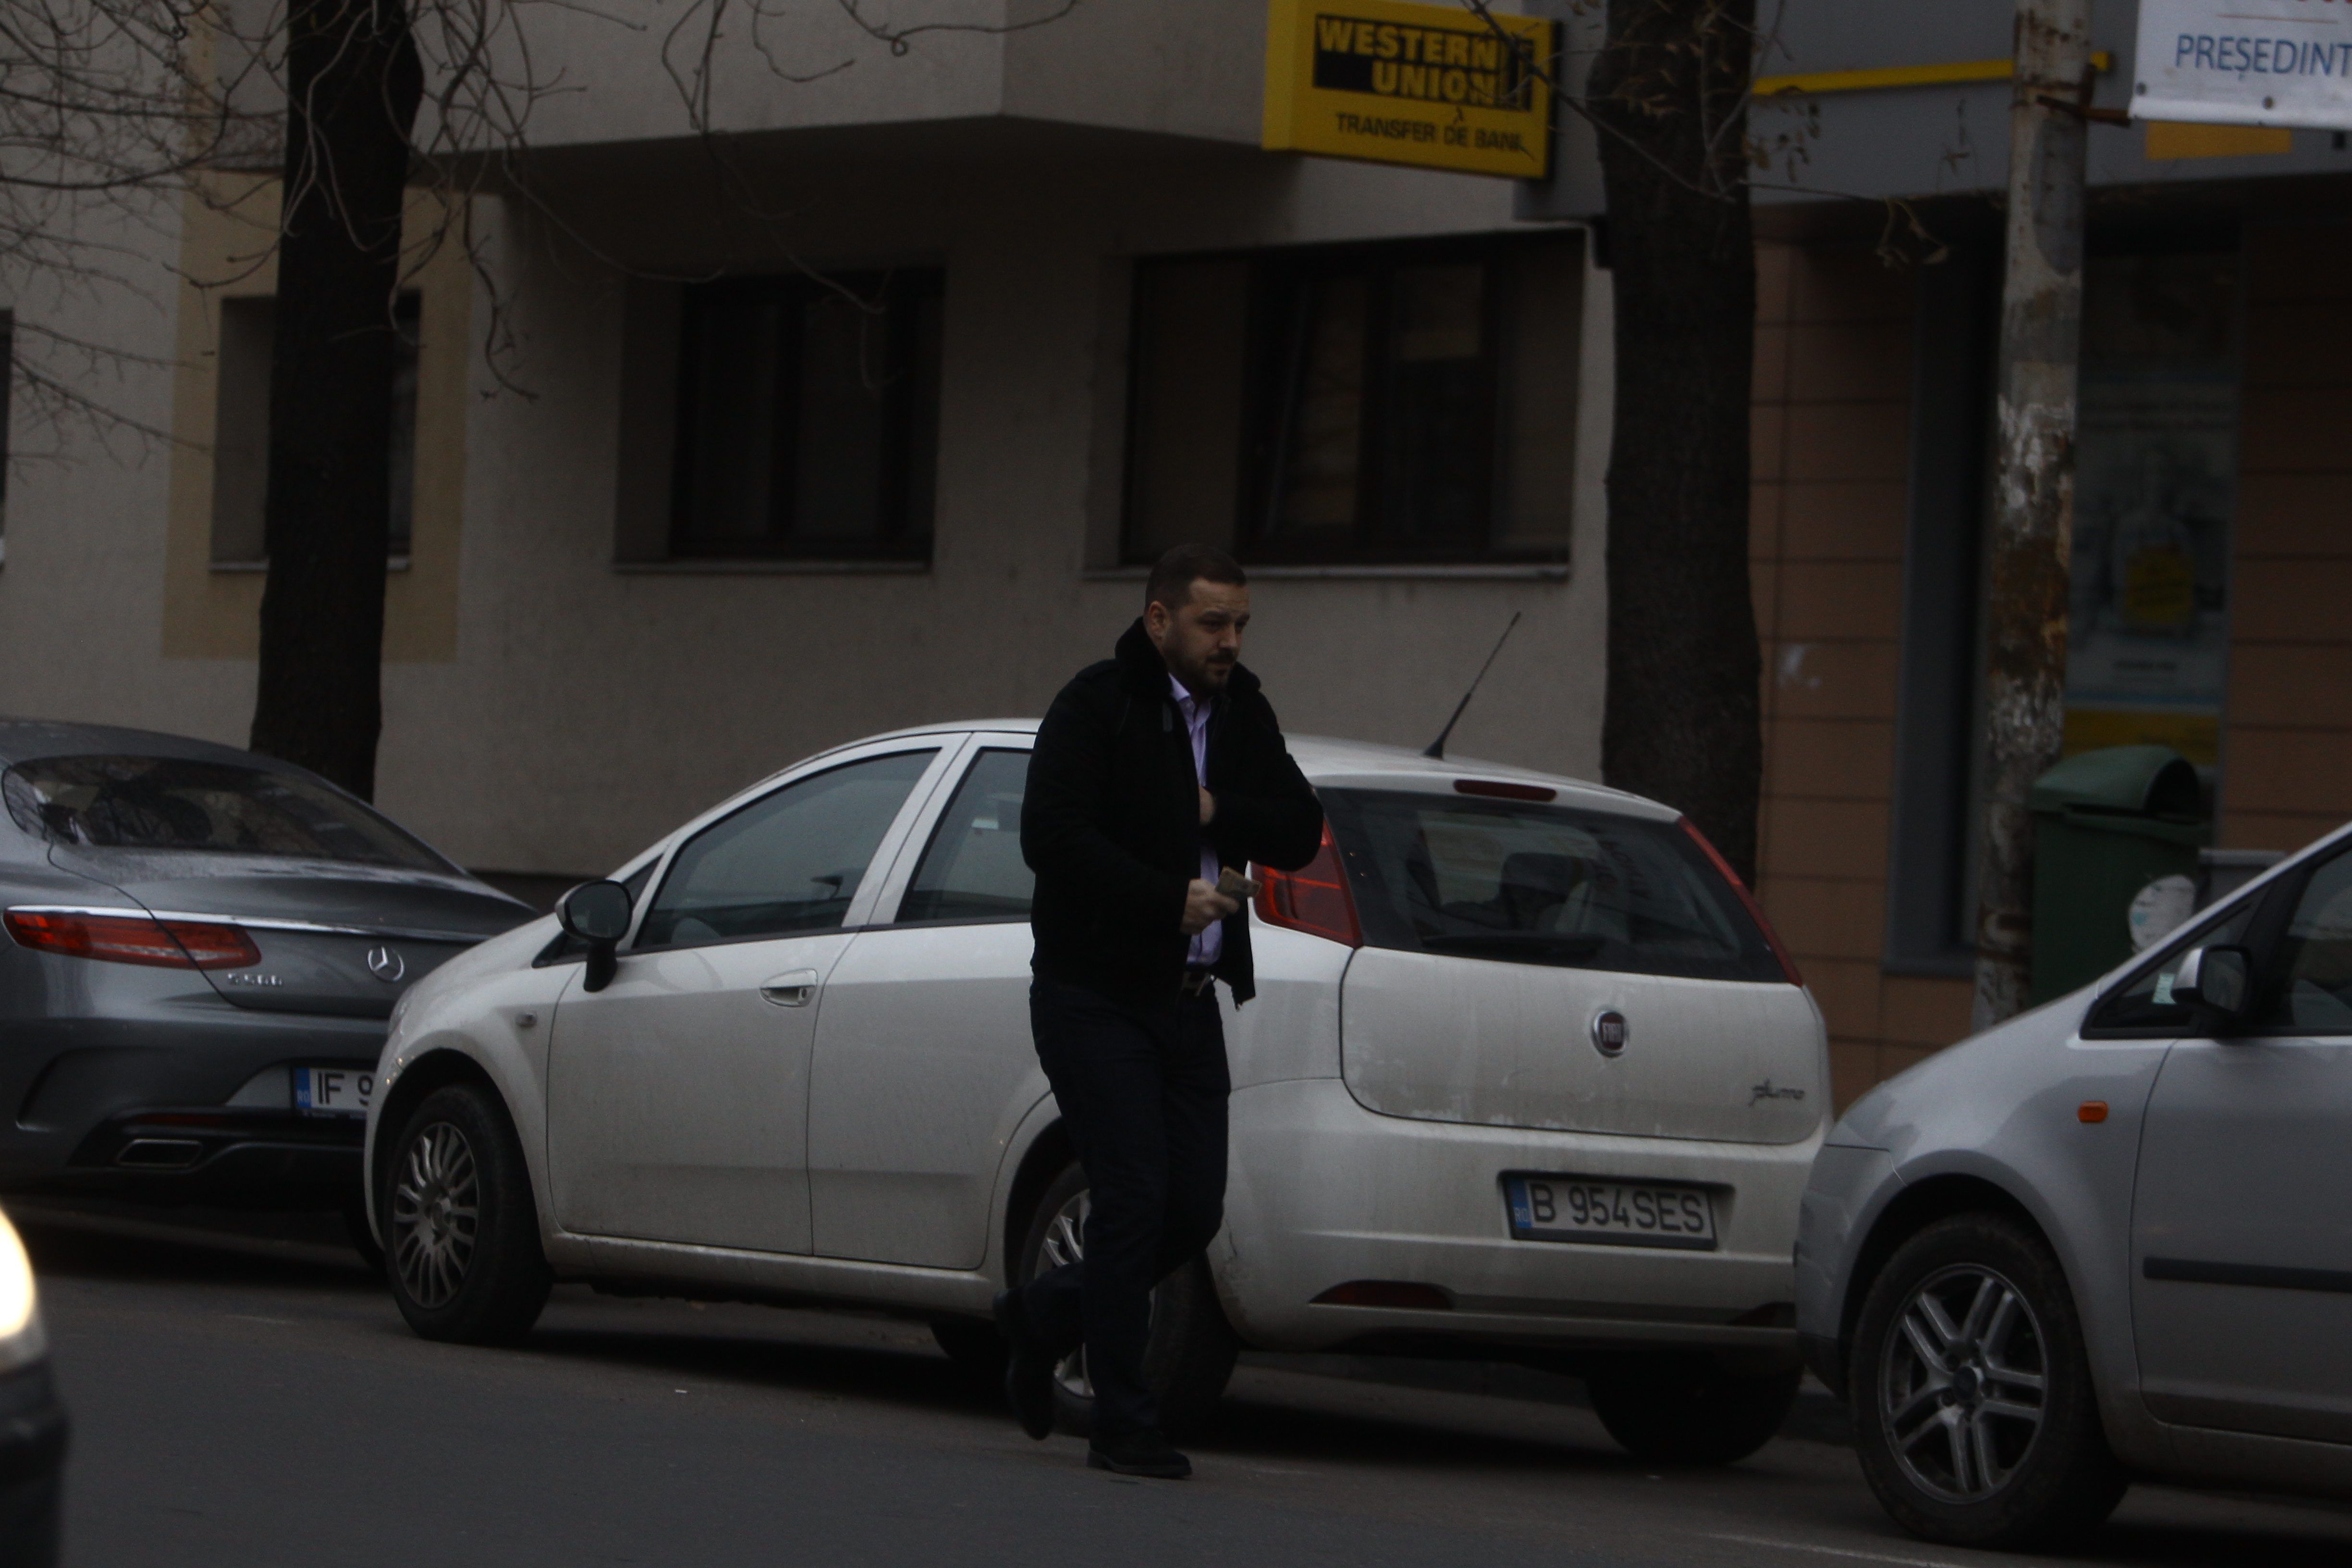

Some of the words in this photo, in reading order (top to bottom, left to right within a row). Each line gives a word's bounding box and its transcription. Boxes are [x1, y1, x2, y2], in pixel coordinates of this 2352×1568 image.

[1318, 19, 1498, 71] WESTERN
[1372, 59, 1495, 105] UNION
[1337, 112, 1436, 143] TRANSFER
[1444, 125, 1469, 146] DE
[318, 1071, 345, 1104] IF
[1530, 1183, 1556, 1223] B
